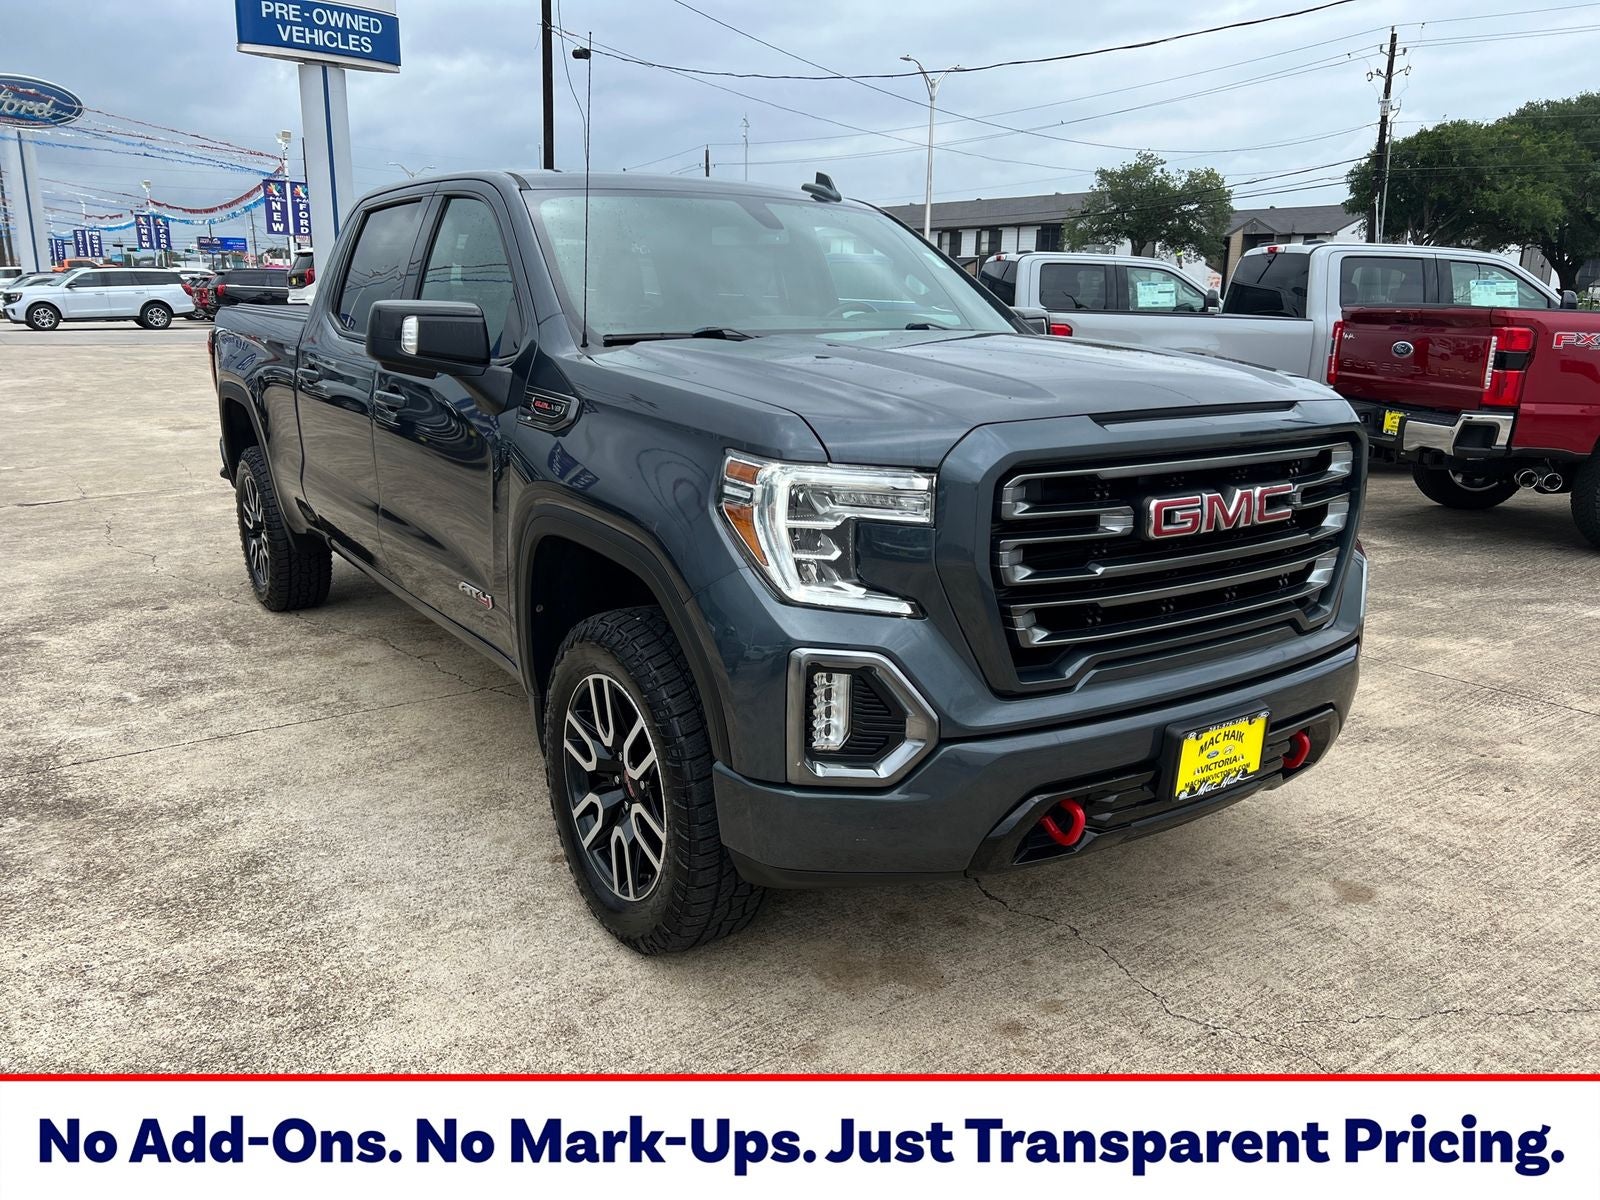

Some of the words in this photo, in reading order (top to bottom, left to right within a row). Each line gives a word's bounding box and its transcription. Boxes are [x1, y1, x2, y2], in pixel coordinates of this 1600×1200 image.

[277, 24, 372, 53] VEHICLES
[271, 201, 284, 232] NEW
[298, 203, 310, 234] FORD
[140, 228, 150, 248] NEW
[159, 228, 168, 249] FORD
[1552, 331, 1600, 350] FX
[1343, 358, 1404, 373] SUPER
[1410, 365, 1473, 379] DUTY
[1149, 483, 1294, 539] GMC
[458, 581, 493, 610] AT4
[1198, 732, 1221, 757] MAC
[1222, 730, 1245, 744] HAIK
[1200, 754, 1238, 774] VICTORIA
